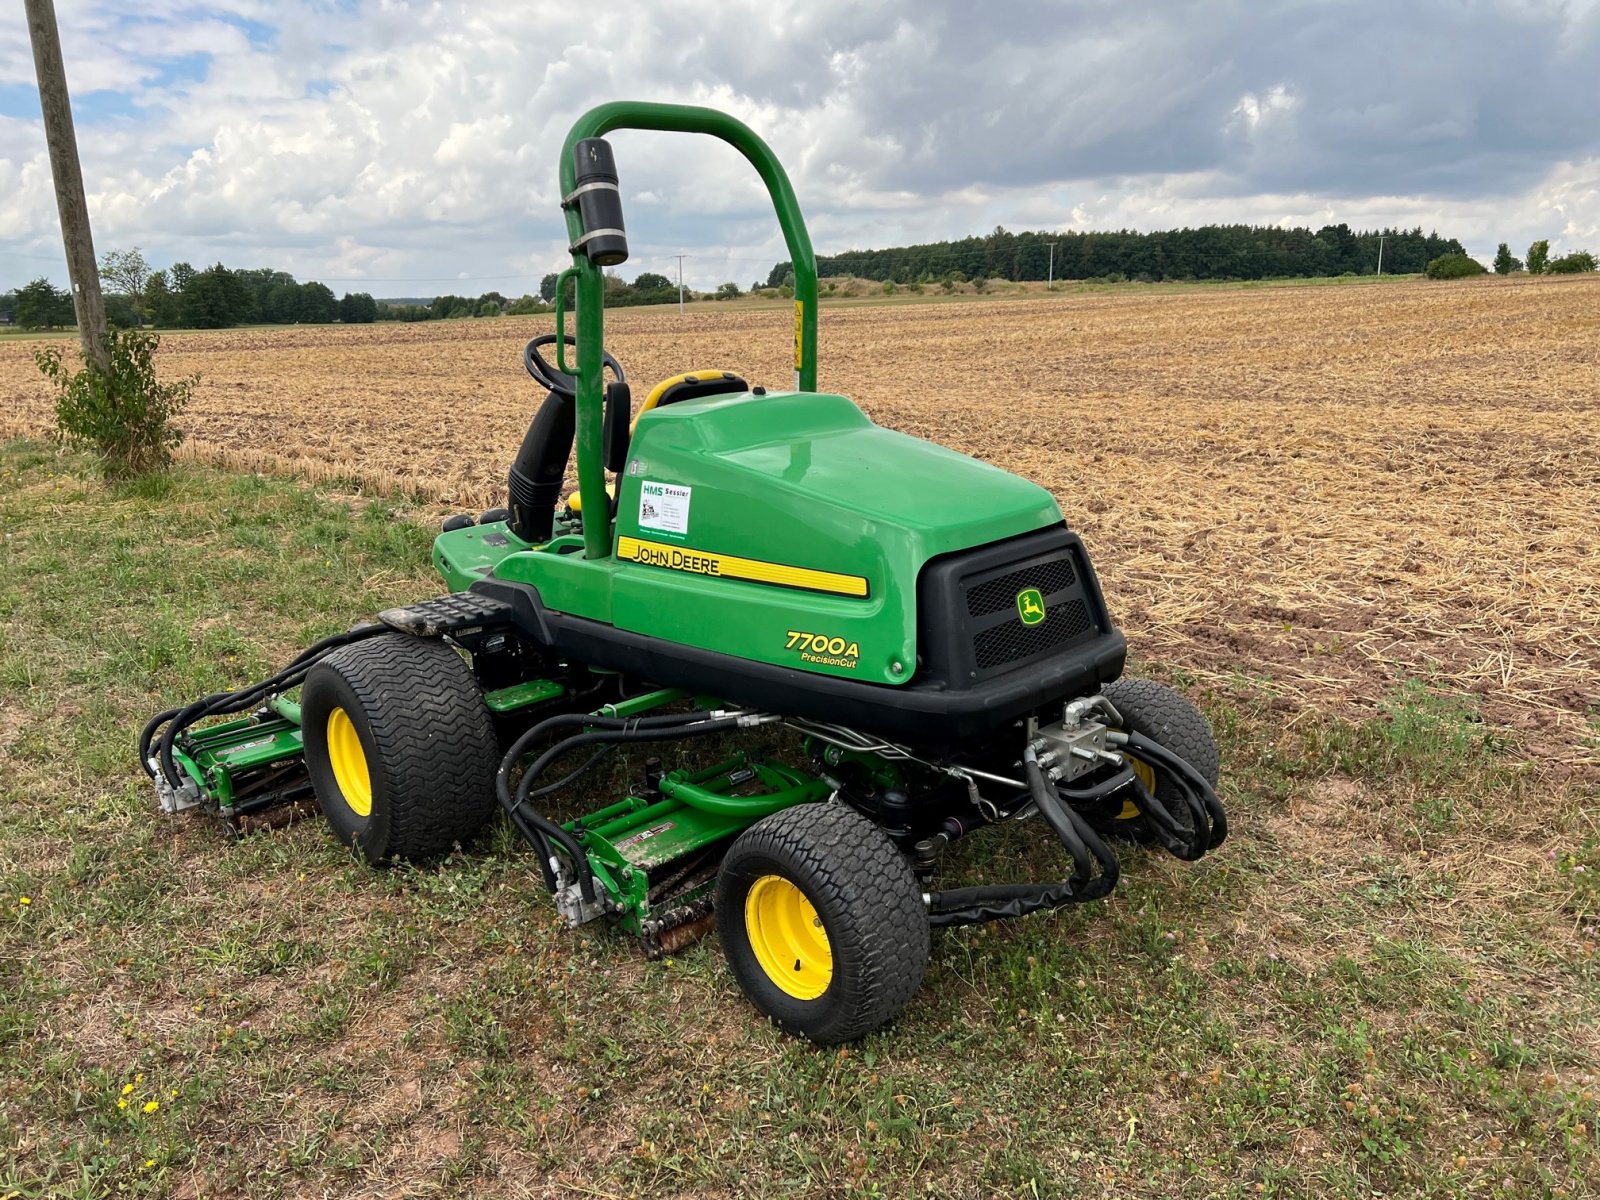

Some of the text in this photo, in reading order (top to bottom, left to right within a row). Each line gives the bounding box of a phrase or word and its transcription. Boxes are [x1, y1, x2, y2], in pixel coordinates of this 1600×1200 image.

[643, 485, 663, 497] HMS
[633, 545, 720, 574] JOHN DEERE
[785, 631, 859, 658] 7700A
[801, 652, 857, 668] PrecisionCut
